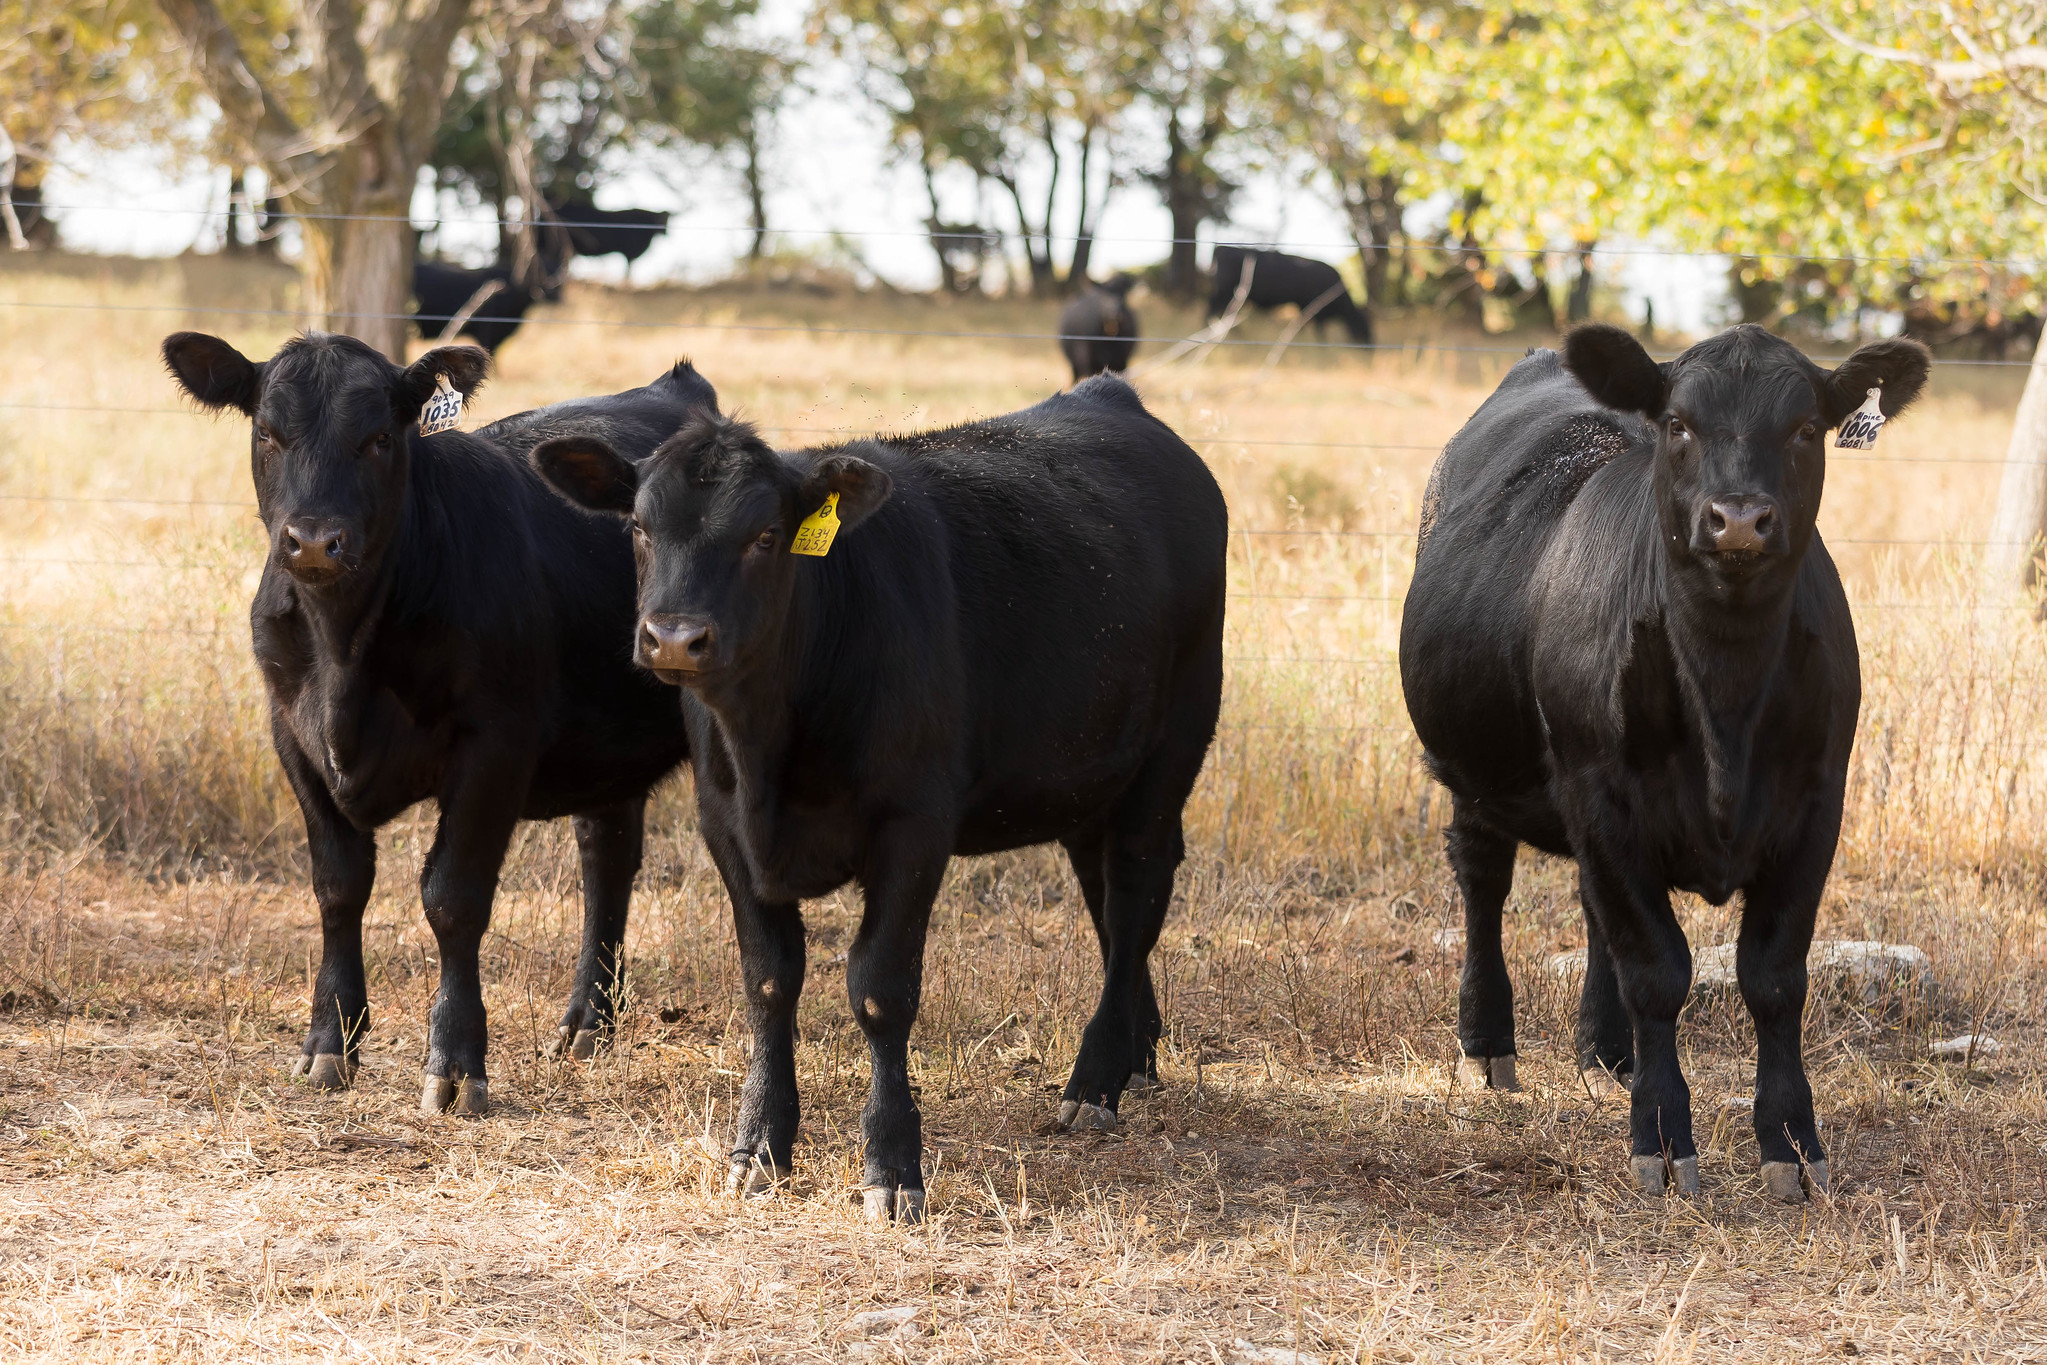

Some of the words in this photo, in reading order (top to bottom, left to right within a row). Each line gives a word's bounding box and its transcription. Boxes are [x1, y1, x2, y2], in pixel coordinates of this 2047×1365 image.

[423, 399, 461, 426] 1035
[1854, 411, 1881, 423] Alpine
[427, 419, 454, 434] 8042
[1838, 420, 1885, 443] 1006
[1839, 439, 1865, 450] 8081
